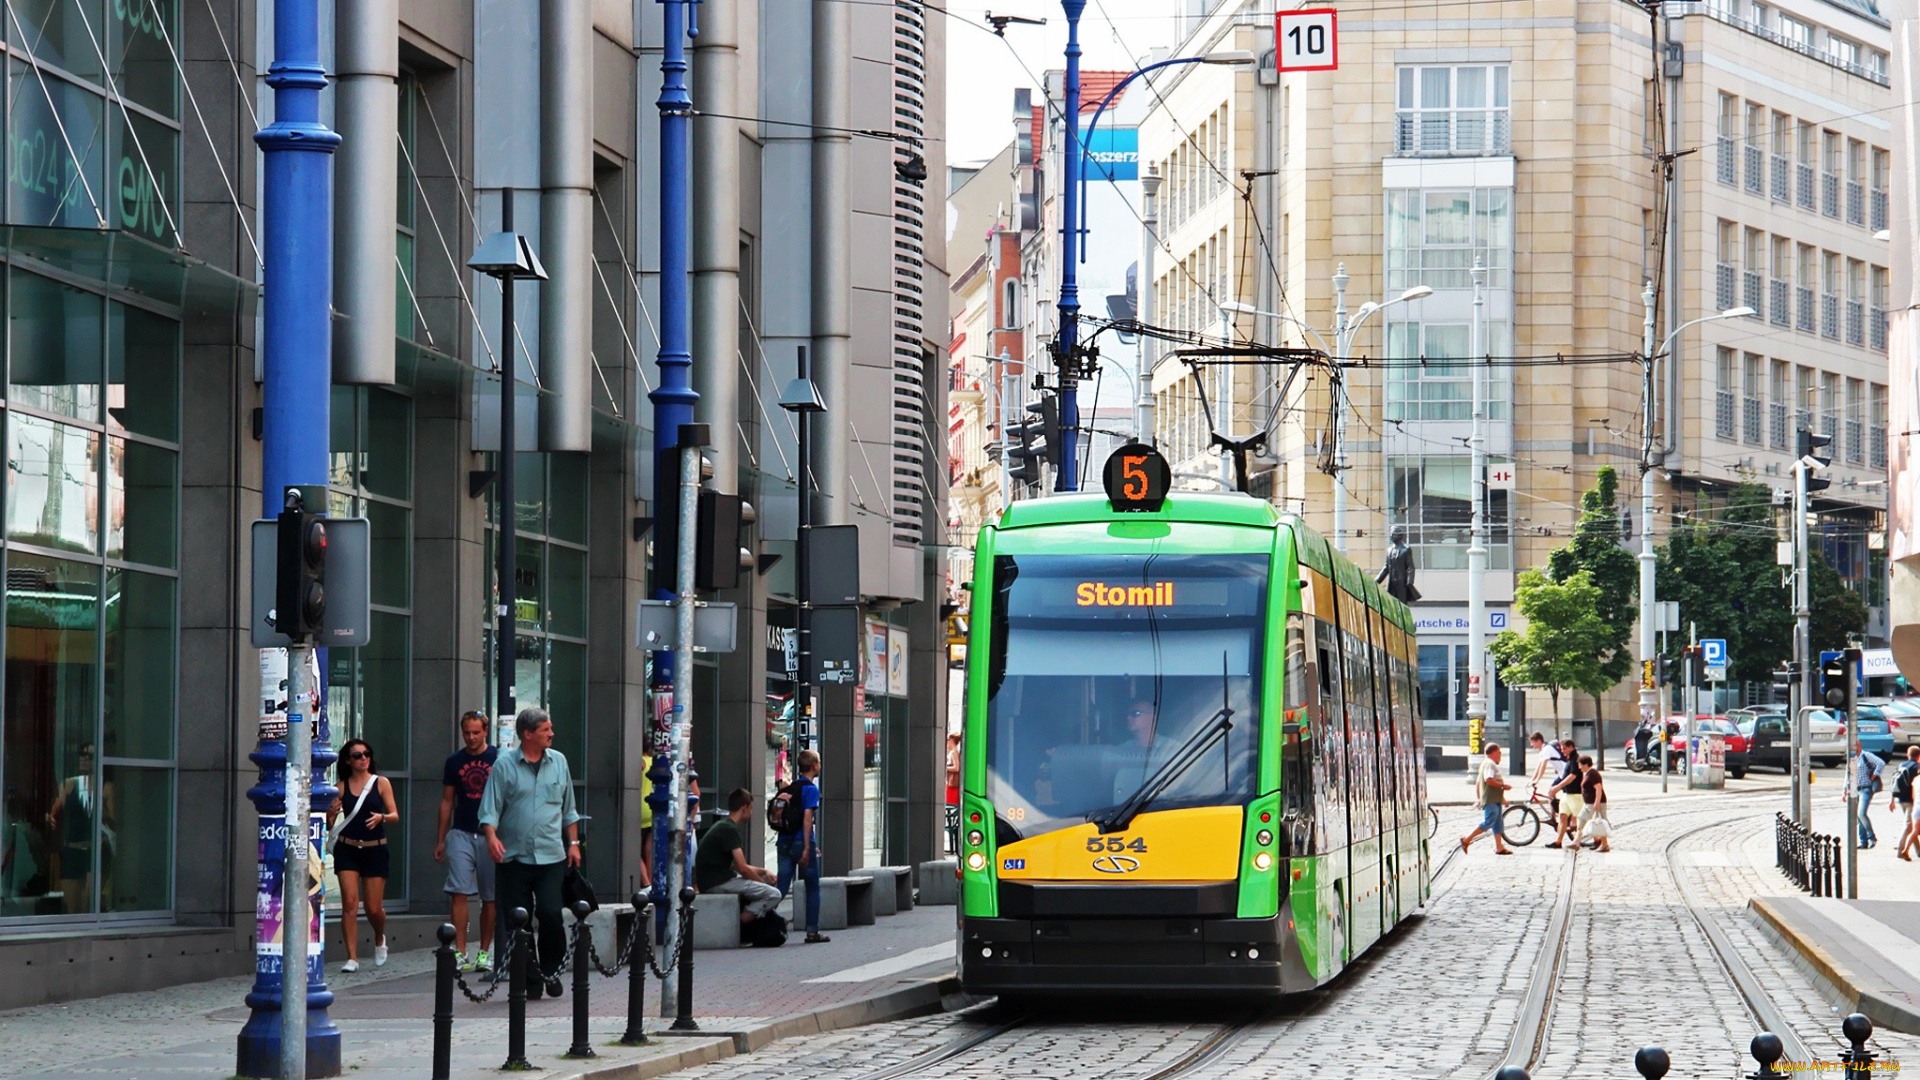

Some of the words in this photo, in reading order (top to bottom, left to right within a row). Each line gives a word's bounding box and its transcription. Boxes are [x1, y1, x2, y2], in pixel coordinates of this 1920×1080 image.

[1288, 25, 1325, 56] 10
[1123, 455, 1148, 501] 5
[1076, 581, 1174, 607] Stomil
[1415, 618, 1452, 628] utsche
[1705, 642, 1720, 663] P
[1867, 657, 1895, 667] NOTA
[1086, 837, 1148, 853] 554
